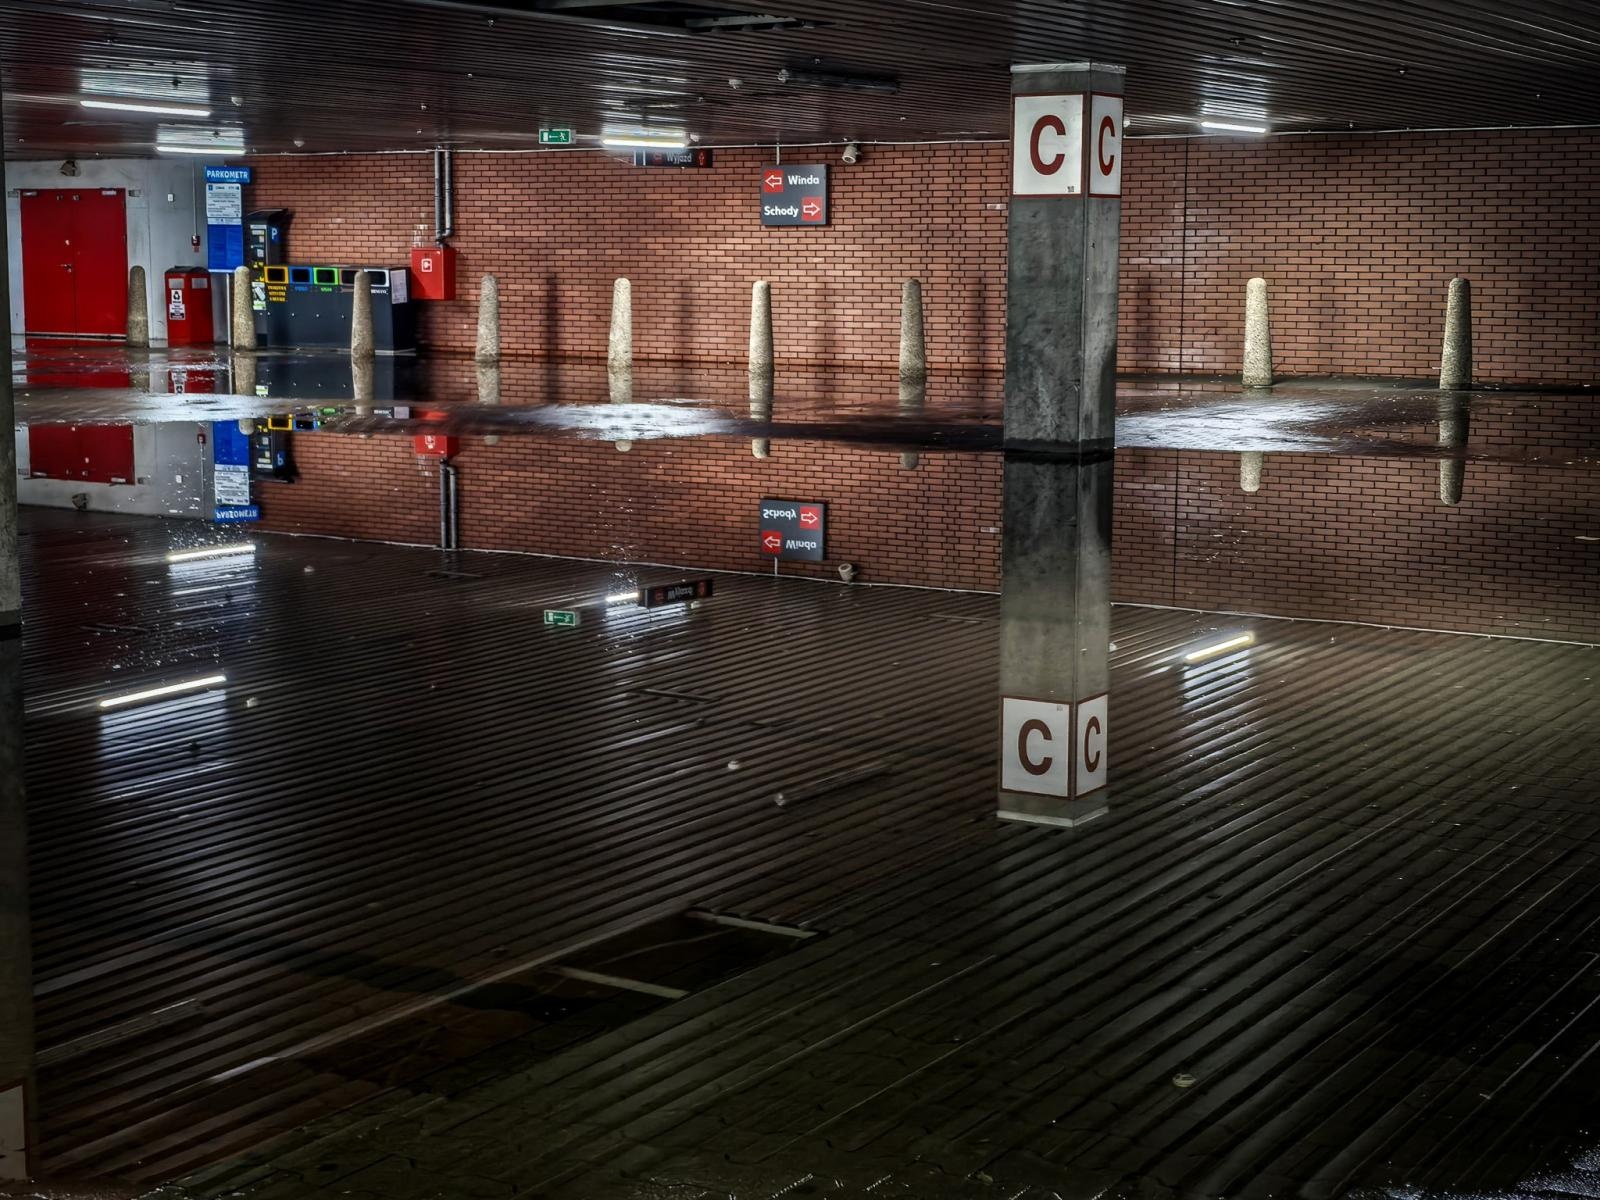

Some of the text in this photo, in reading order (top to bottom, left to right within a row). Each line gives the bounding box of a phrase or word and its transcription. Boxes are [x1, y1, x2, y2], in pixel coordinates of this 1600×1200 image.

[1030, 115, 1066, 175] C
[1098, 115, 1115, 176] C
[666, 151, 692, 165] Wyjazd
[206, 170, 248, 179] PARKOMETR
[787, 174, 820, 185] Winda
[763, 205, 799, 218] Schody
[271, 227, 278, 240] P
